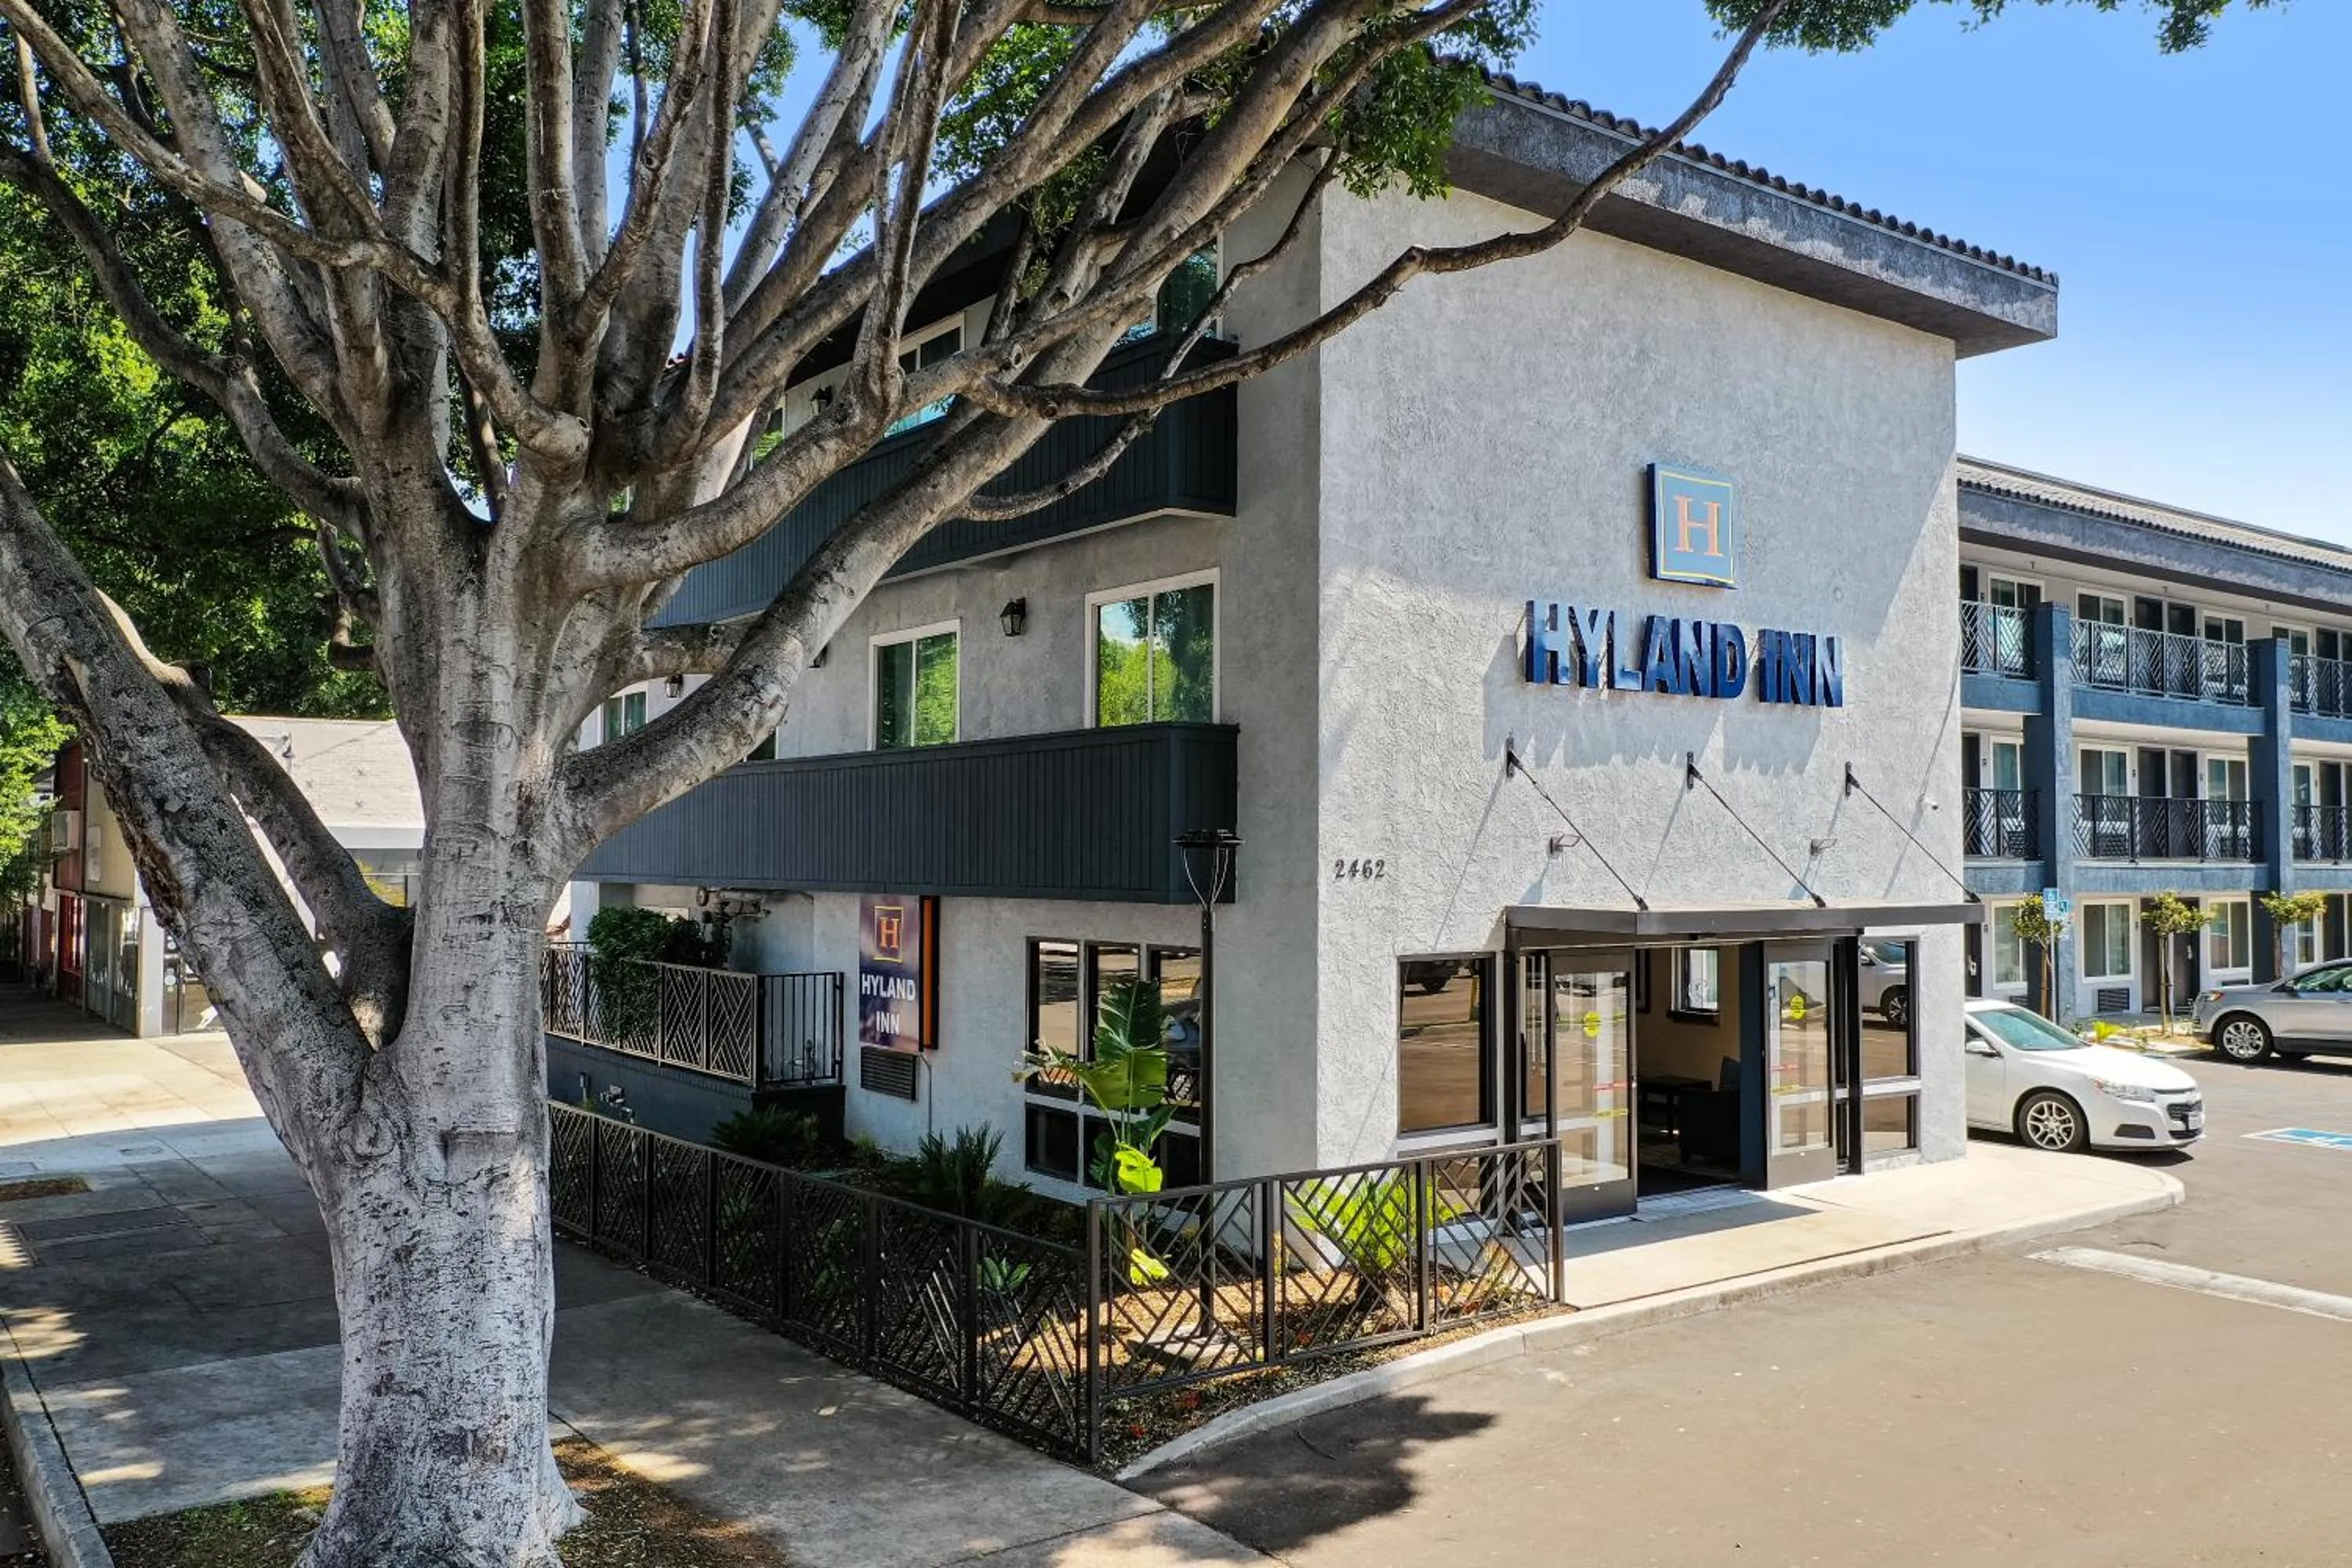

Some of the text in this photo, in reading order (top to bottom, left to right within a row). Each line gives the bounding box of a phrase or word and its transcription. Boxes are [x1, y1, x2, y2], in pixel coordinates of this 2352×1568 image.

[1673, 495, 1723, 556] H
[1525, 600, 1843, 707] HYLAND INN
[1334, 858, 1385, 879] 2462
[879, 916, 900, 948] H
[862, 974, 916, 1000] HYLAND
[876, 1011, 900, 1035] INN
